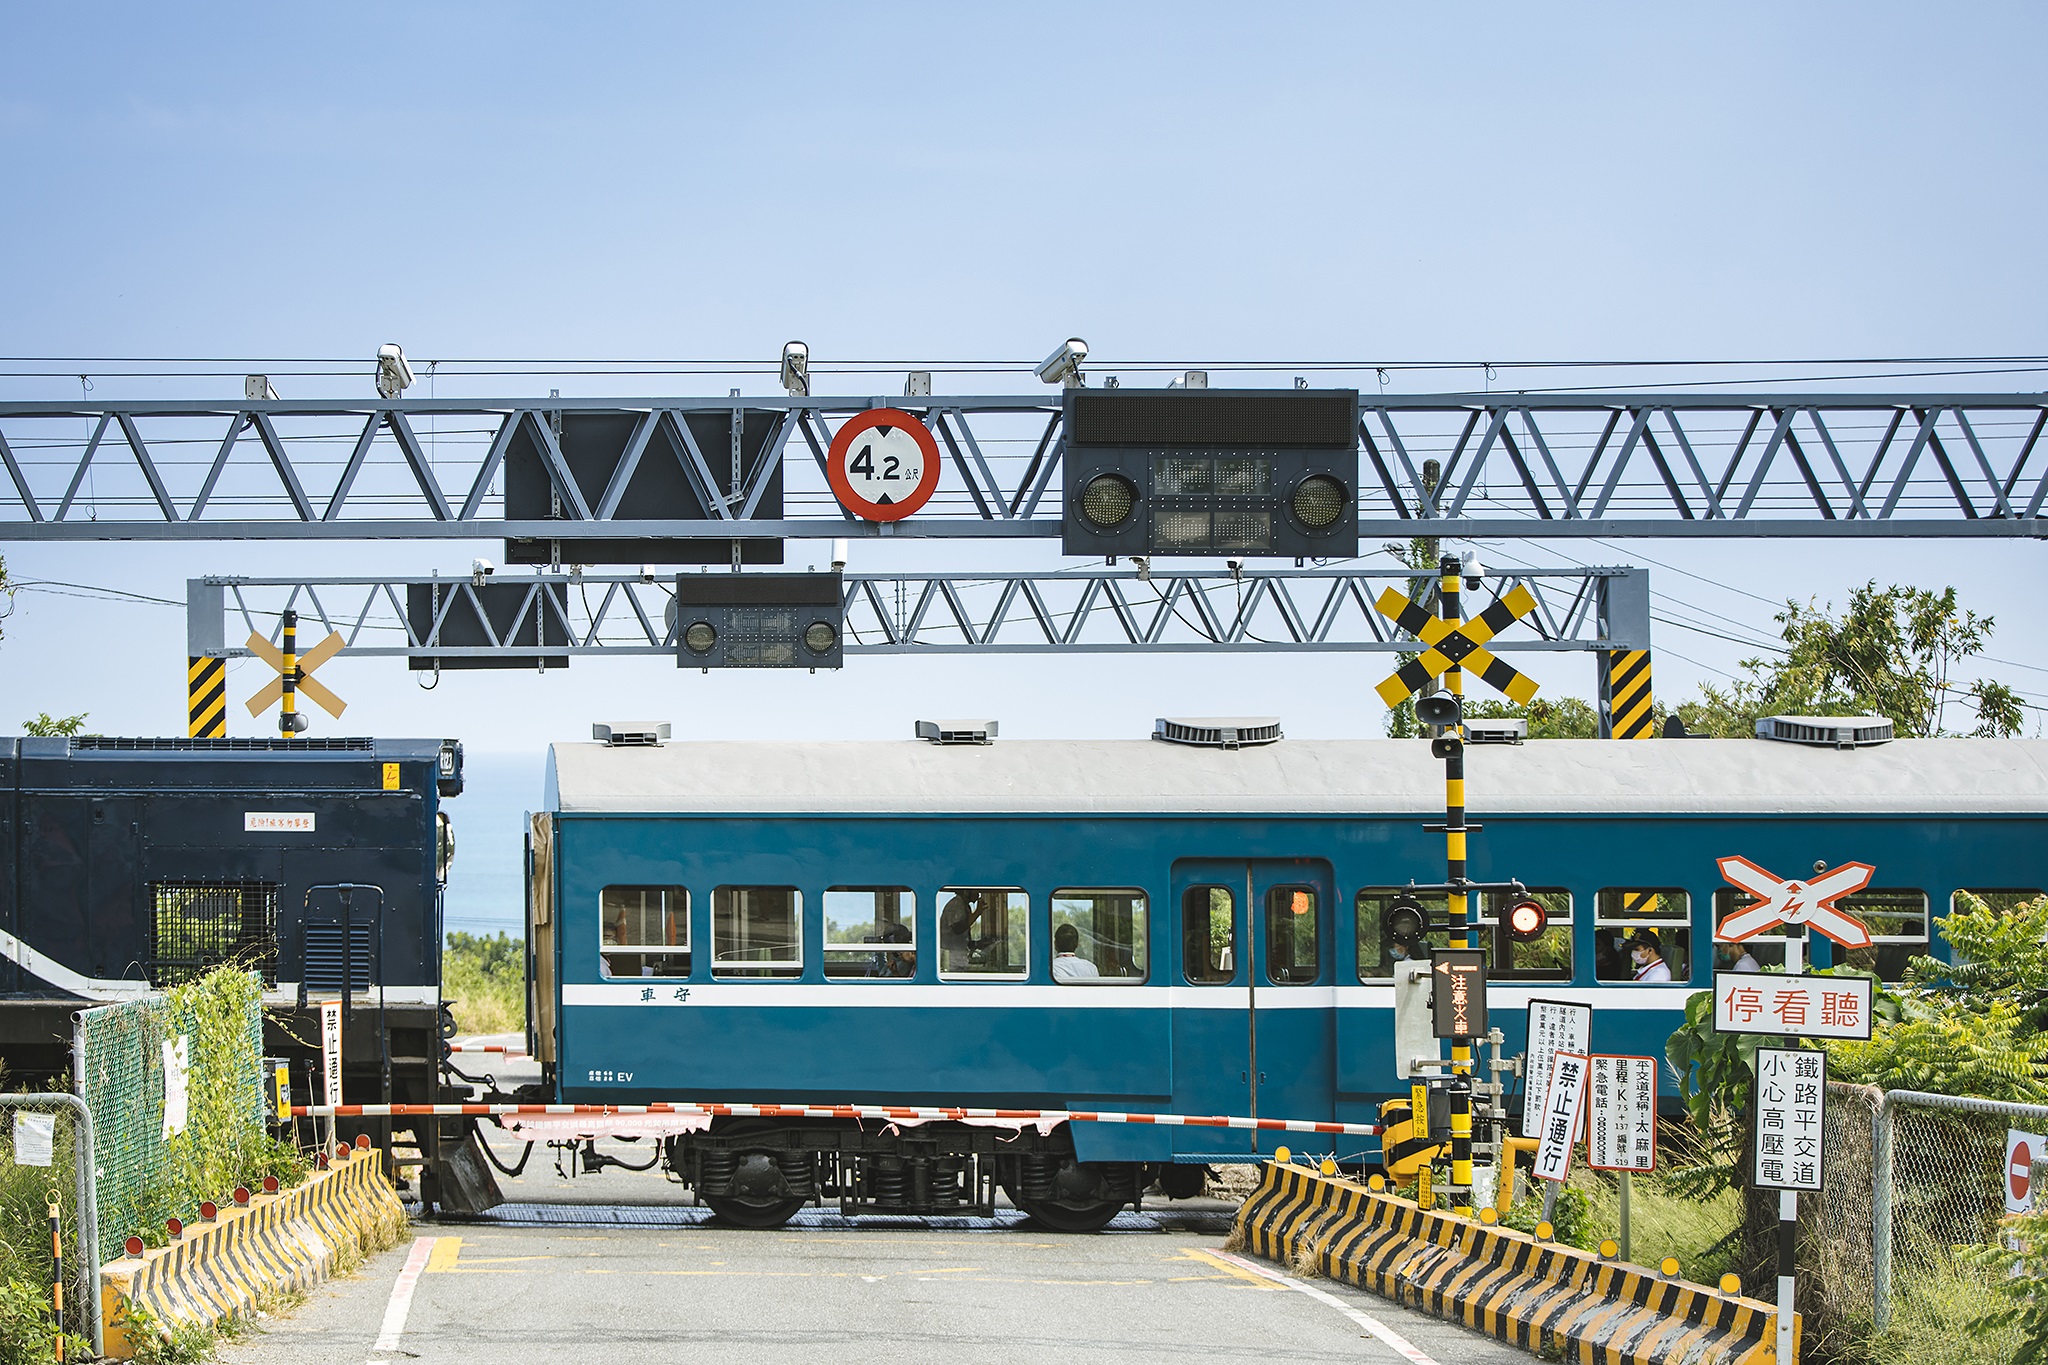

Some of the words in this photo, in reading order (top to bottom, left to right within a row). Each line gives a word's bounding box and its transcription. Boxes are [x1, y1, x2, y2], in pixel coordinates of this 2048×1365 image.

[850, 445, 900, 480] 4.2
[1451, 974, 1468, 1035] 注意火車
[1724, 987, 1860, 1027] 停看聽
[326, 1010, 339, 1104] 禁止通行
[617, 1072, 634, 1082] EV
[1543, 1061, 1579, 1173] 禁止通行
[1760, 1055, 1786, 1182] 小心高壓電
[1792, 1056, 1819, 1185] 鐵路平交道
